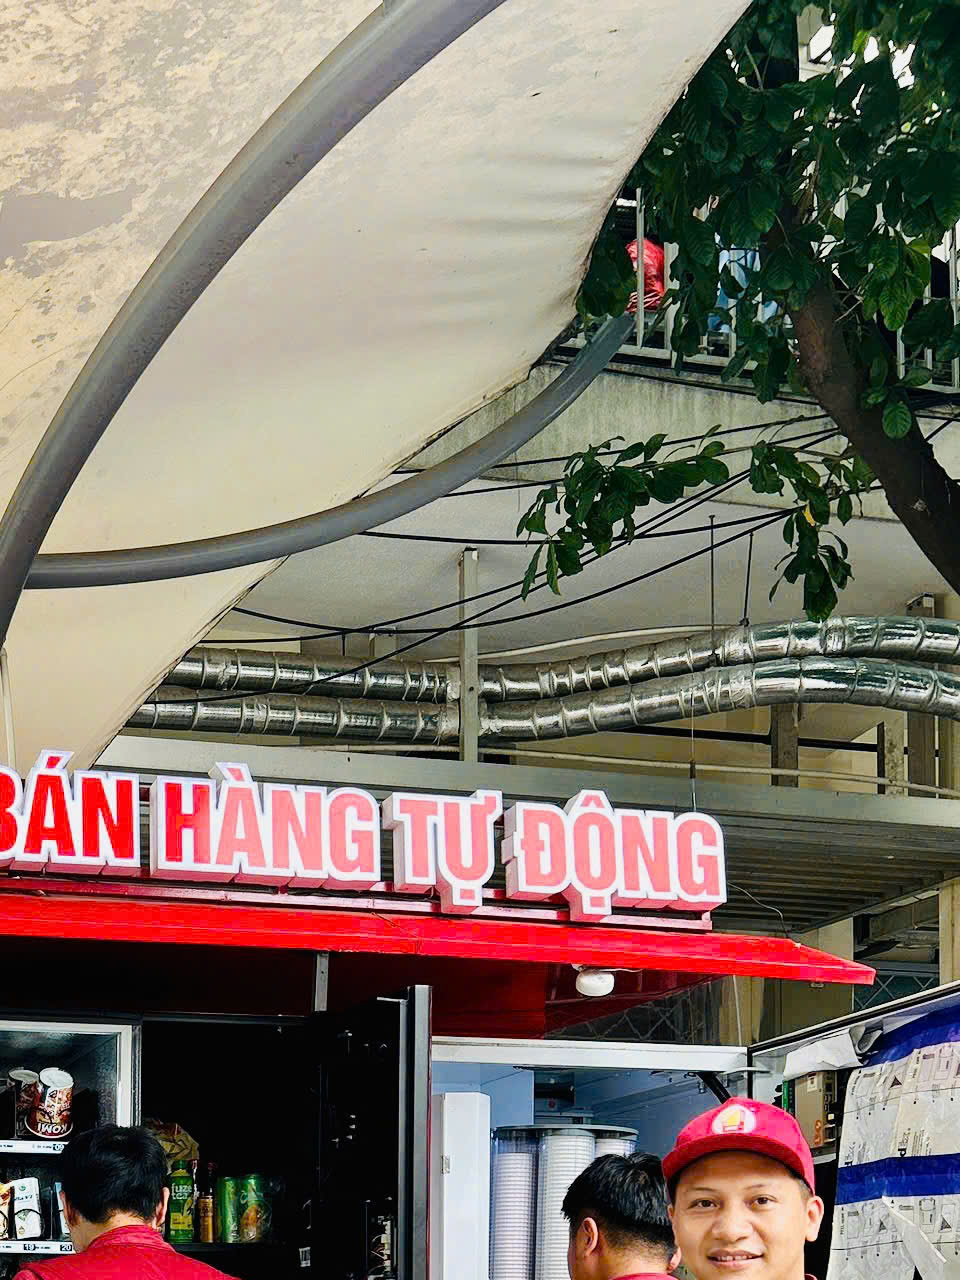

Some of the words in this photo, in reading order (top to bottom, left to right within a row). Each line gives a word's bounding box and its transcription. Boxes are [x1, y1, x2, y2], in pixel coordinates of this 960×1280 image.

[163, 768, 378, 875] HÀNG
[399, 792, 501, 902] TỰ
[517, 792, 723, 908] ĐỘNG
[23, 1243, 36, 1251] 19
